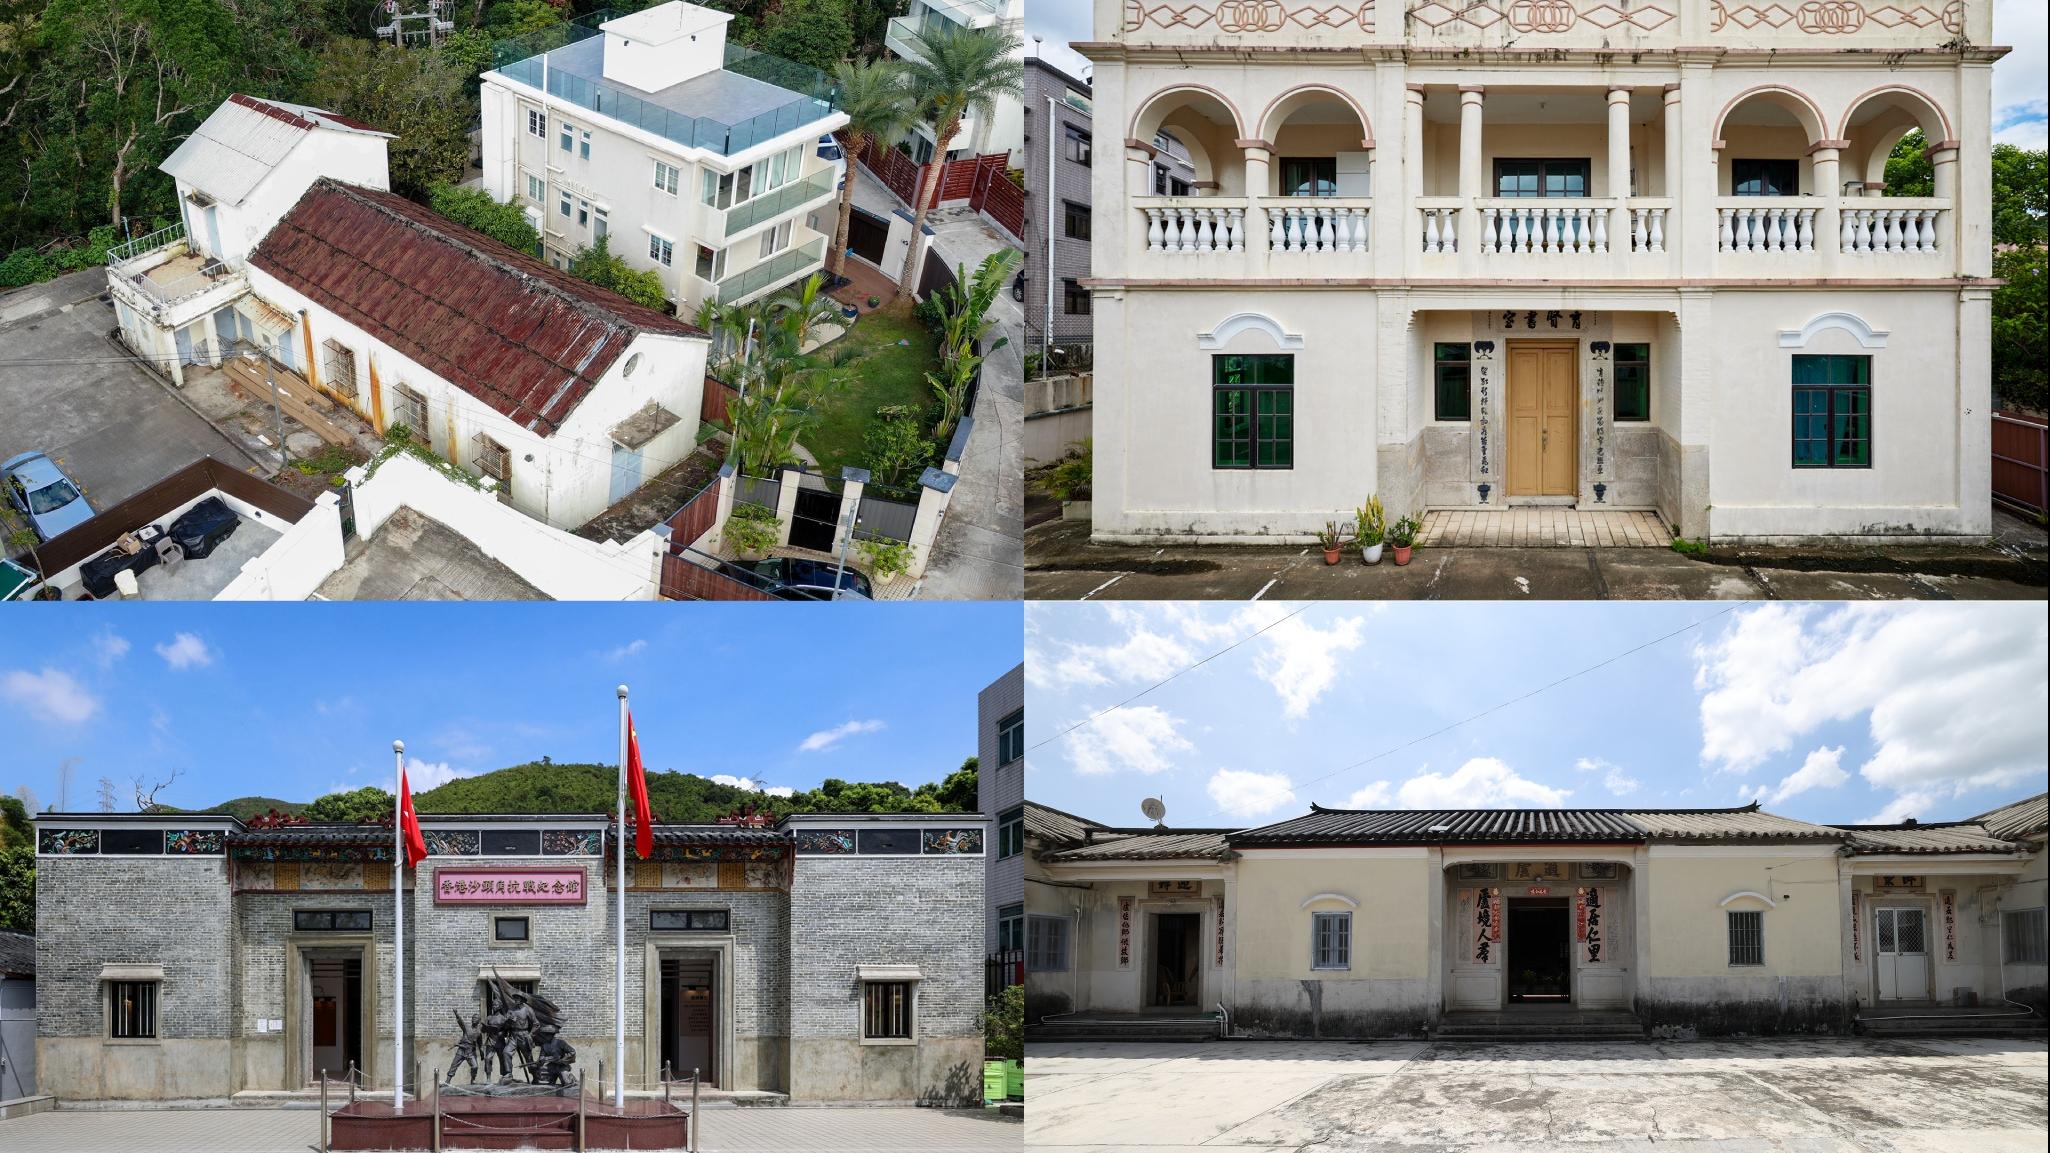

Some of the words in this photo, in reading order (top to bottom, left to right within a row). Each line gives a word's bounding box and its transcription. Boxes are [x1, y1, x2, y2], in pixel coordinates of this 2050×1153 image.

[440, 880, 580, 895] 香港沙頭角抗戰紀念館
